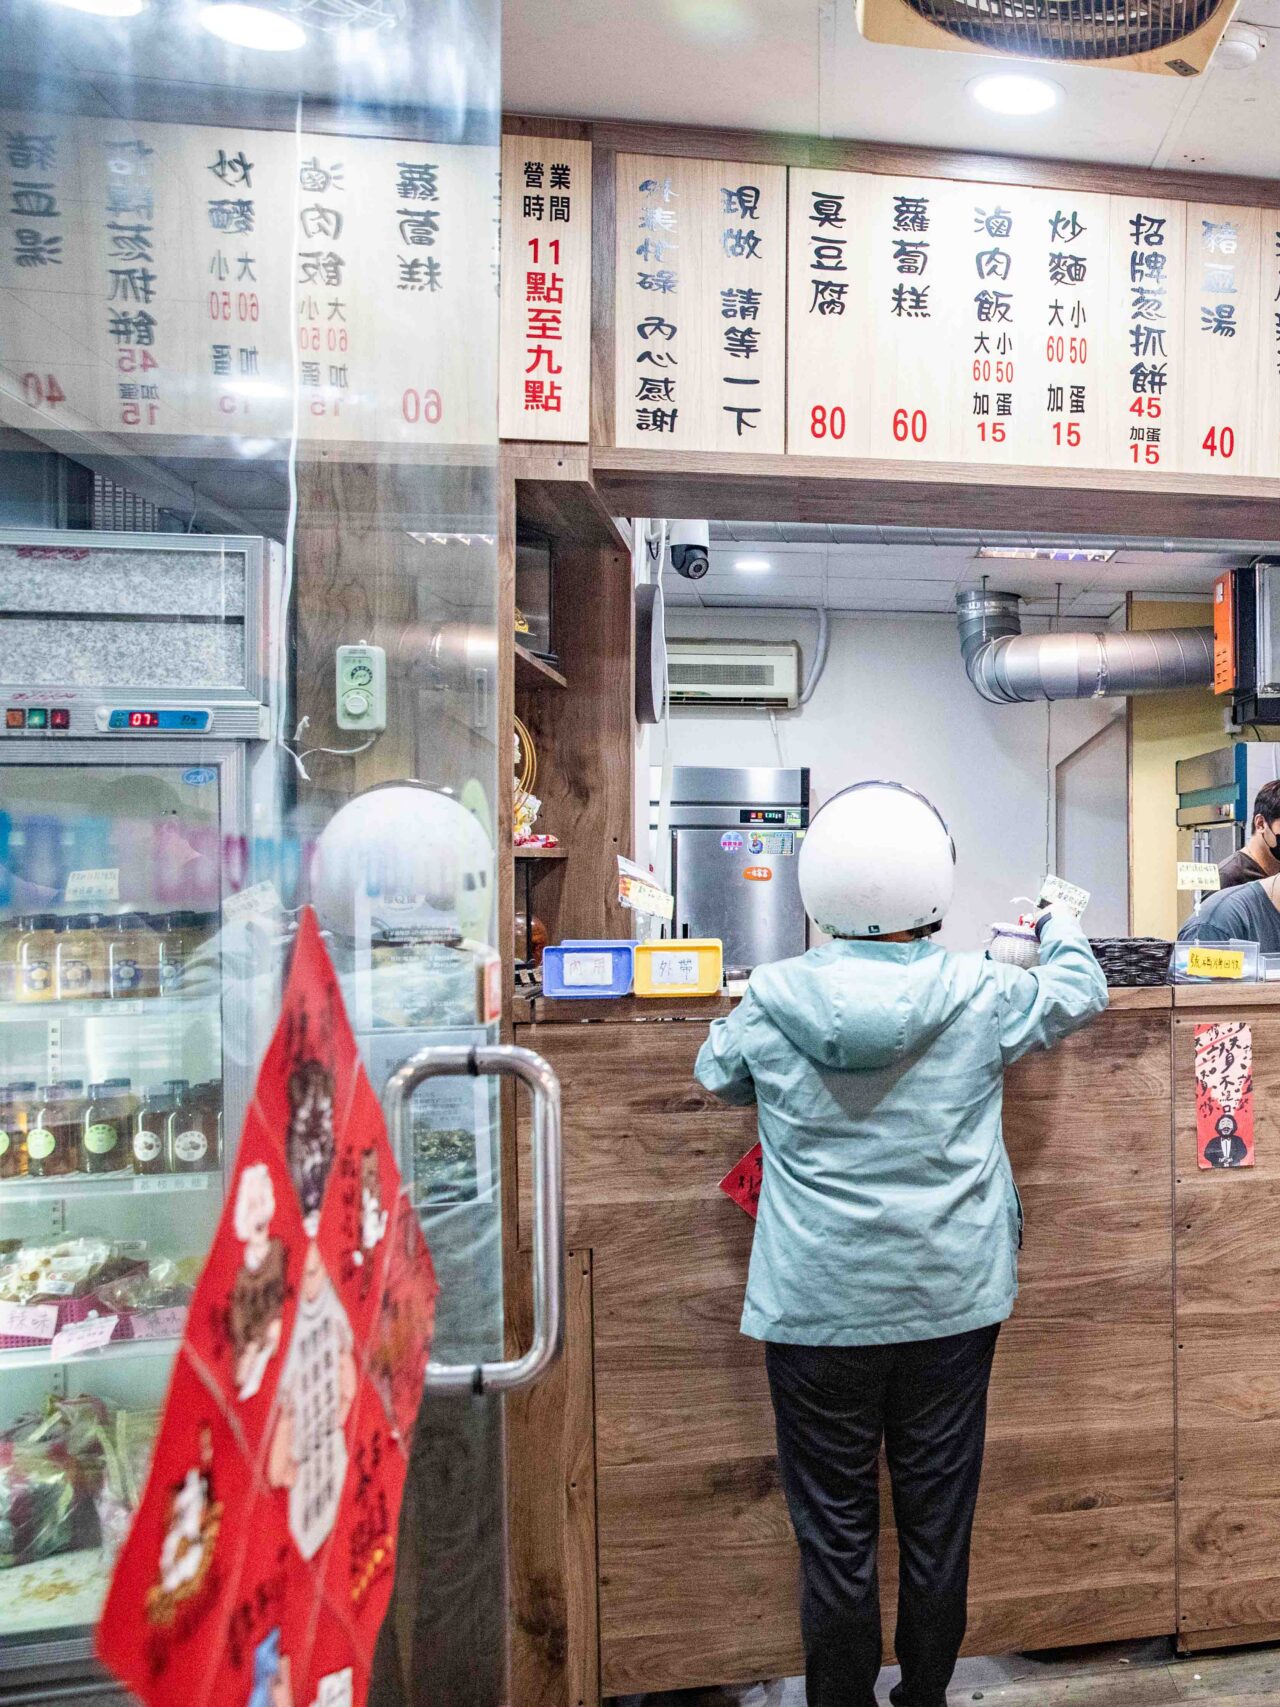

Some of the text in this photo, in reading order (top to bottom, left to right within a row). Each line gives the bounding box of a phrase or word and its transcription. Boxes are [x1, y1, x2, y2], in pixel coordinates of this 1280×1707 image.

[523, 162, 571, 190] 營業
[523, 195, 570, 223] 時間
[891, 196, 931, 318] 蘿蔔糕
[1048, 210, 1088, 287] 炒麵
[973, 205, 1015, 324] 滷肉飯
[720, 288, 763, 436] 請等一下
[1046, 336, 1087, 364] 60 50
[973, 361, 1013, 383] 60 50
[973, 392, 1013, 416] 加蛋
[1047, 384, 1086, 413] 加蛋
[1129, 396, 1162, 419] 45
[811, 405, 846, 439] 80
[893, 408, 927, 442] 60
[977, 422, 1006, 443] 15
[1052, 421, 1081, 447] 15
[1129, 426, 1161, 443] 加蛋
[1129, 444, 1160, 464] 15
[1202, 426, 1235, 458] 40
